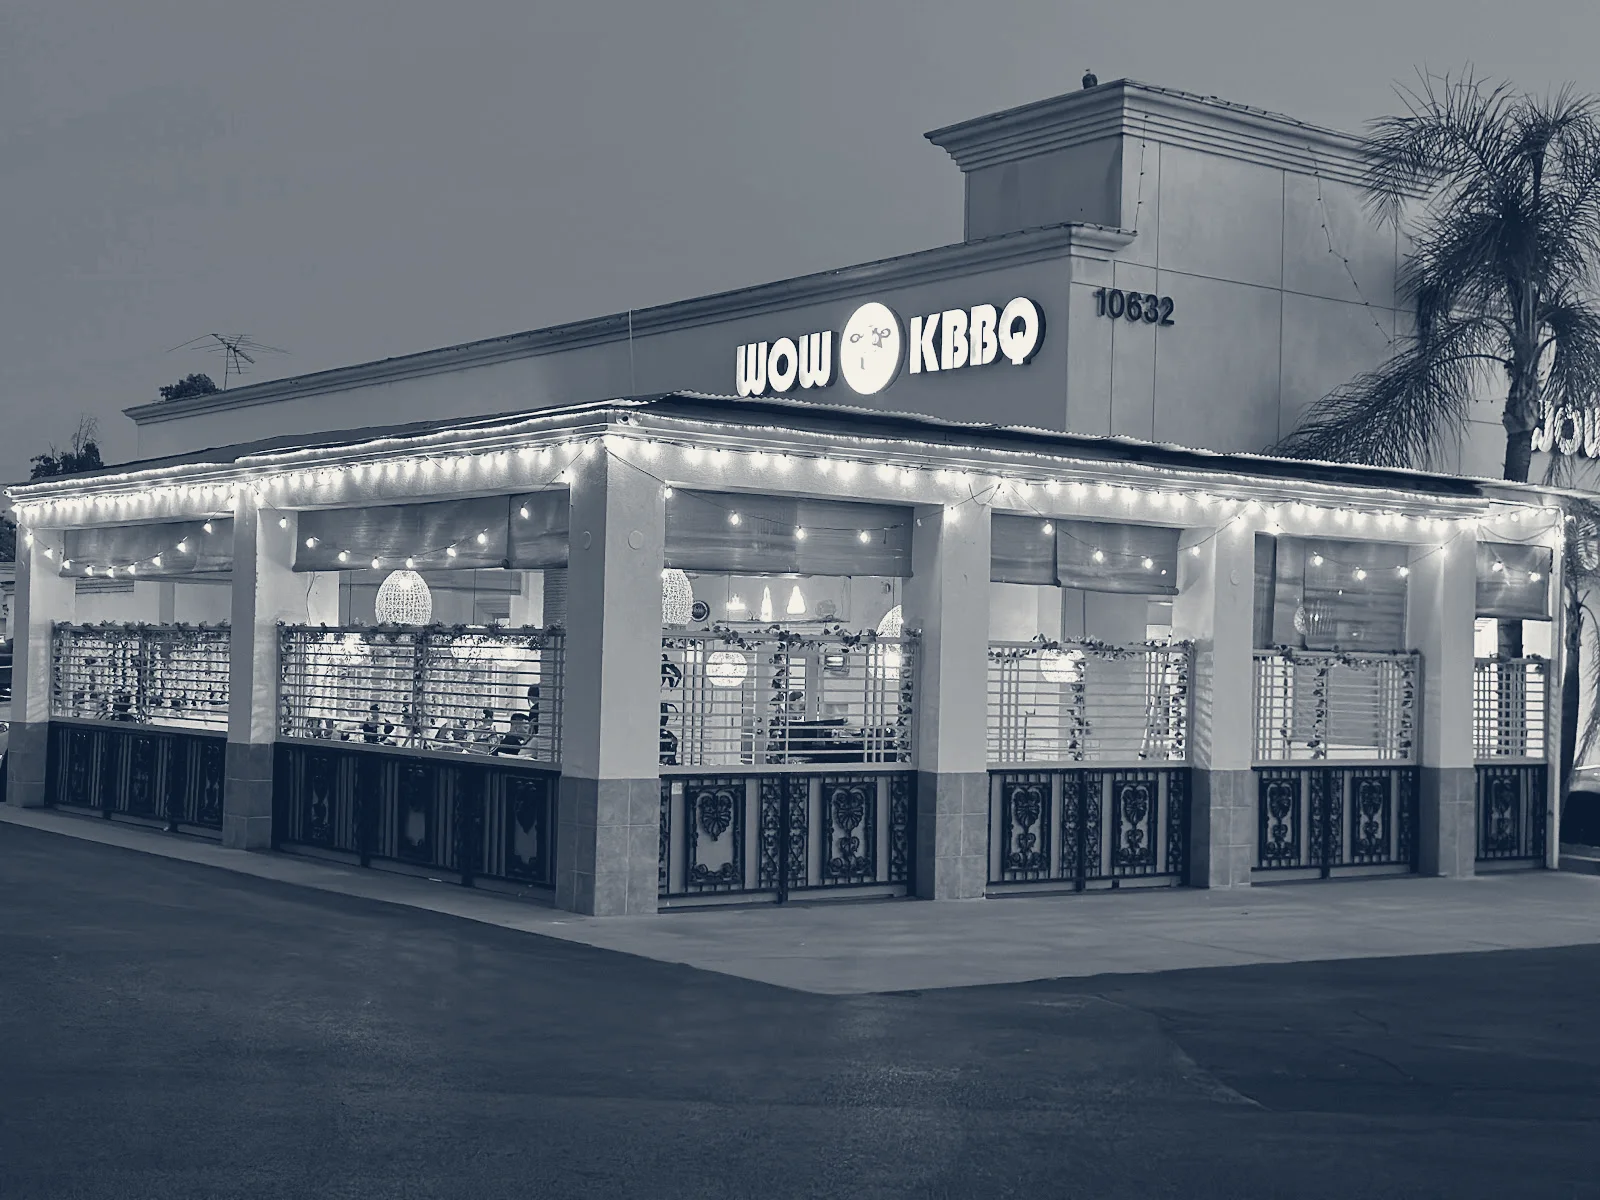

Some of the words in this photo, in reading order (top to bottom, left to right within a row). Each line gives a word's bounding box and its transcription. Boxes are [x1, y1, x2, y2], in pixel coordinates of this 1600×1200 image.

[1093, 287, 1175, 326] 10632
[736, 330, 833, 398] WOW
[909, 296, 1042, 375] KBBQ
